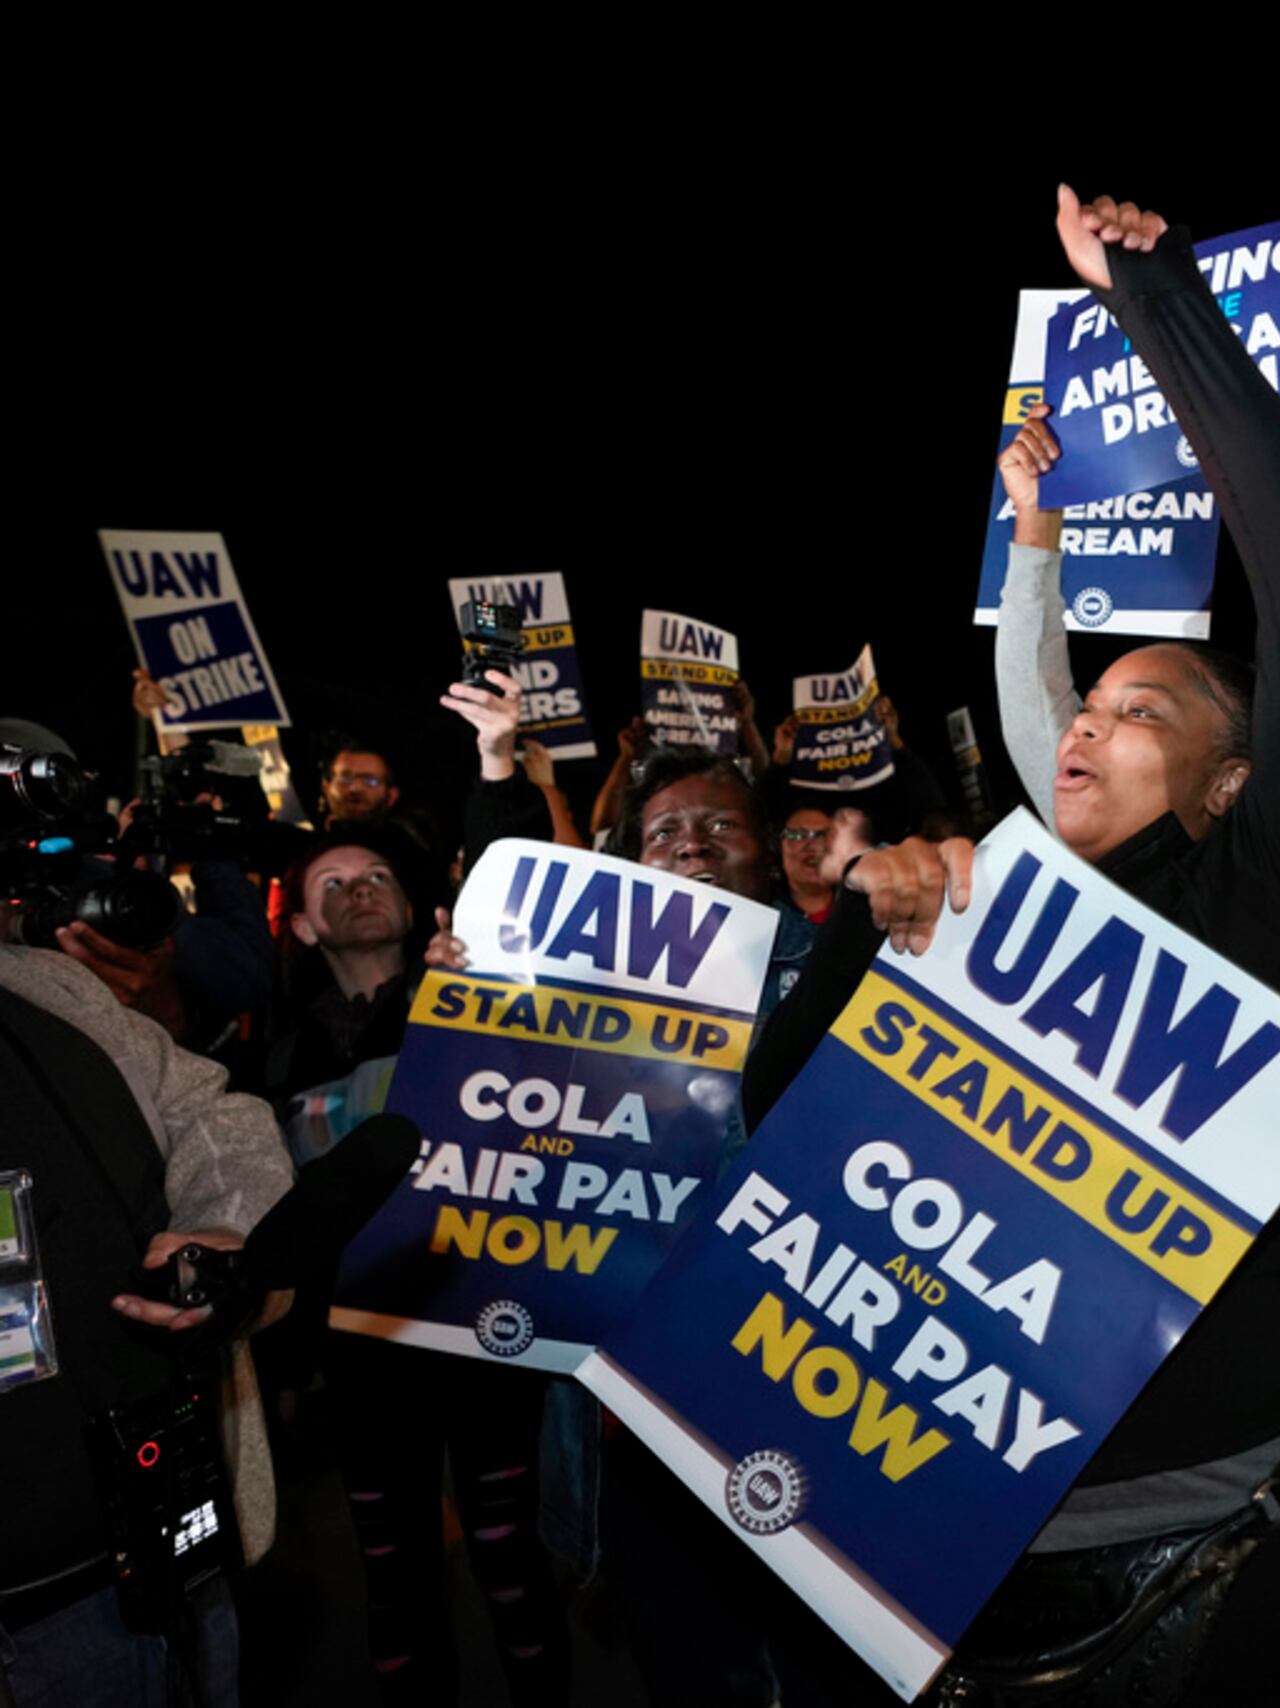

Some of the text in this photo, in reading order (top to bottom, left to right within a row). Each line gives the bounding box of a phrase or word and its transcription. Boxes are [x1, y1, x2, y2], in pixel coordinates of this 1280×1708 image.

[1059, 527, 1174, 556] REAM
[112, 549, 222, 599] UAW
[168, 615, 218, 665] ON
[660, 617, 724, 661] UAW
[158, 652, 265, 719] STRIKE
[816, 719, 873, 743] COLA
[817, 752, 873, 771] NOW
[499, 857, 731, 989] UAW
[430, 983, 730, 1059] STAND UP
[460, 1069, 651, 1145] COLA
[859, 1000, 1213, 1262] STAND UP
[520, 1134, 574, 1157] AND
[557, 1162, 701, 1223] PAY
[429, 1206, 619, 1275] NOW
[842, 1139, 1063, 1346] COLA
[884, 1254, 948, 1307] AND
[714, 1171, 1082, 1475] FAIR PAY
[730, 1291, 952, 1484] NOW
